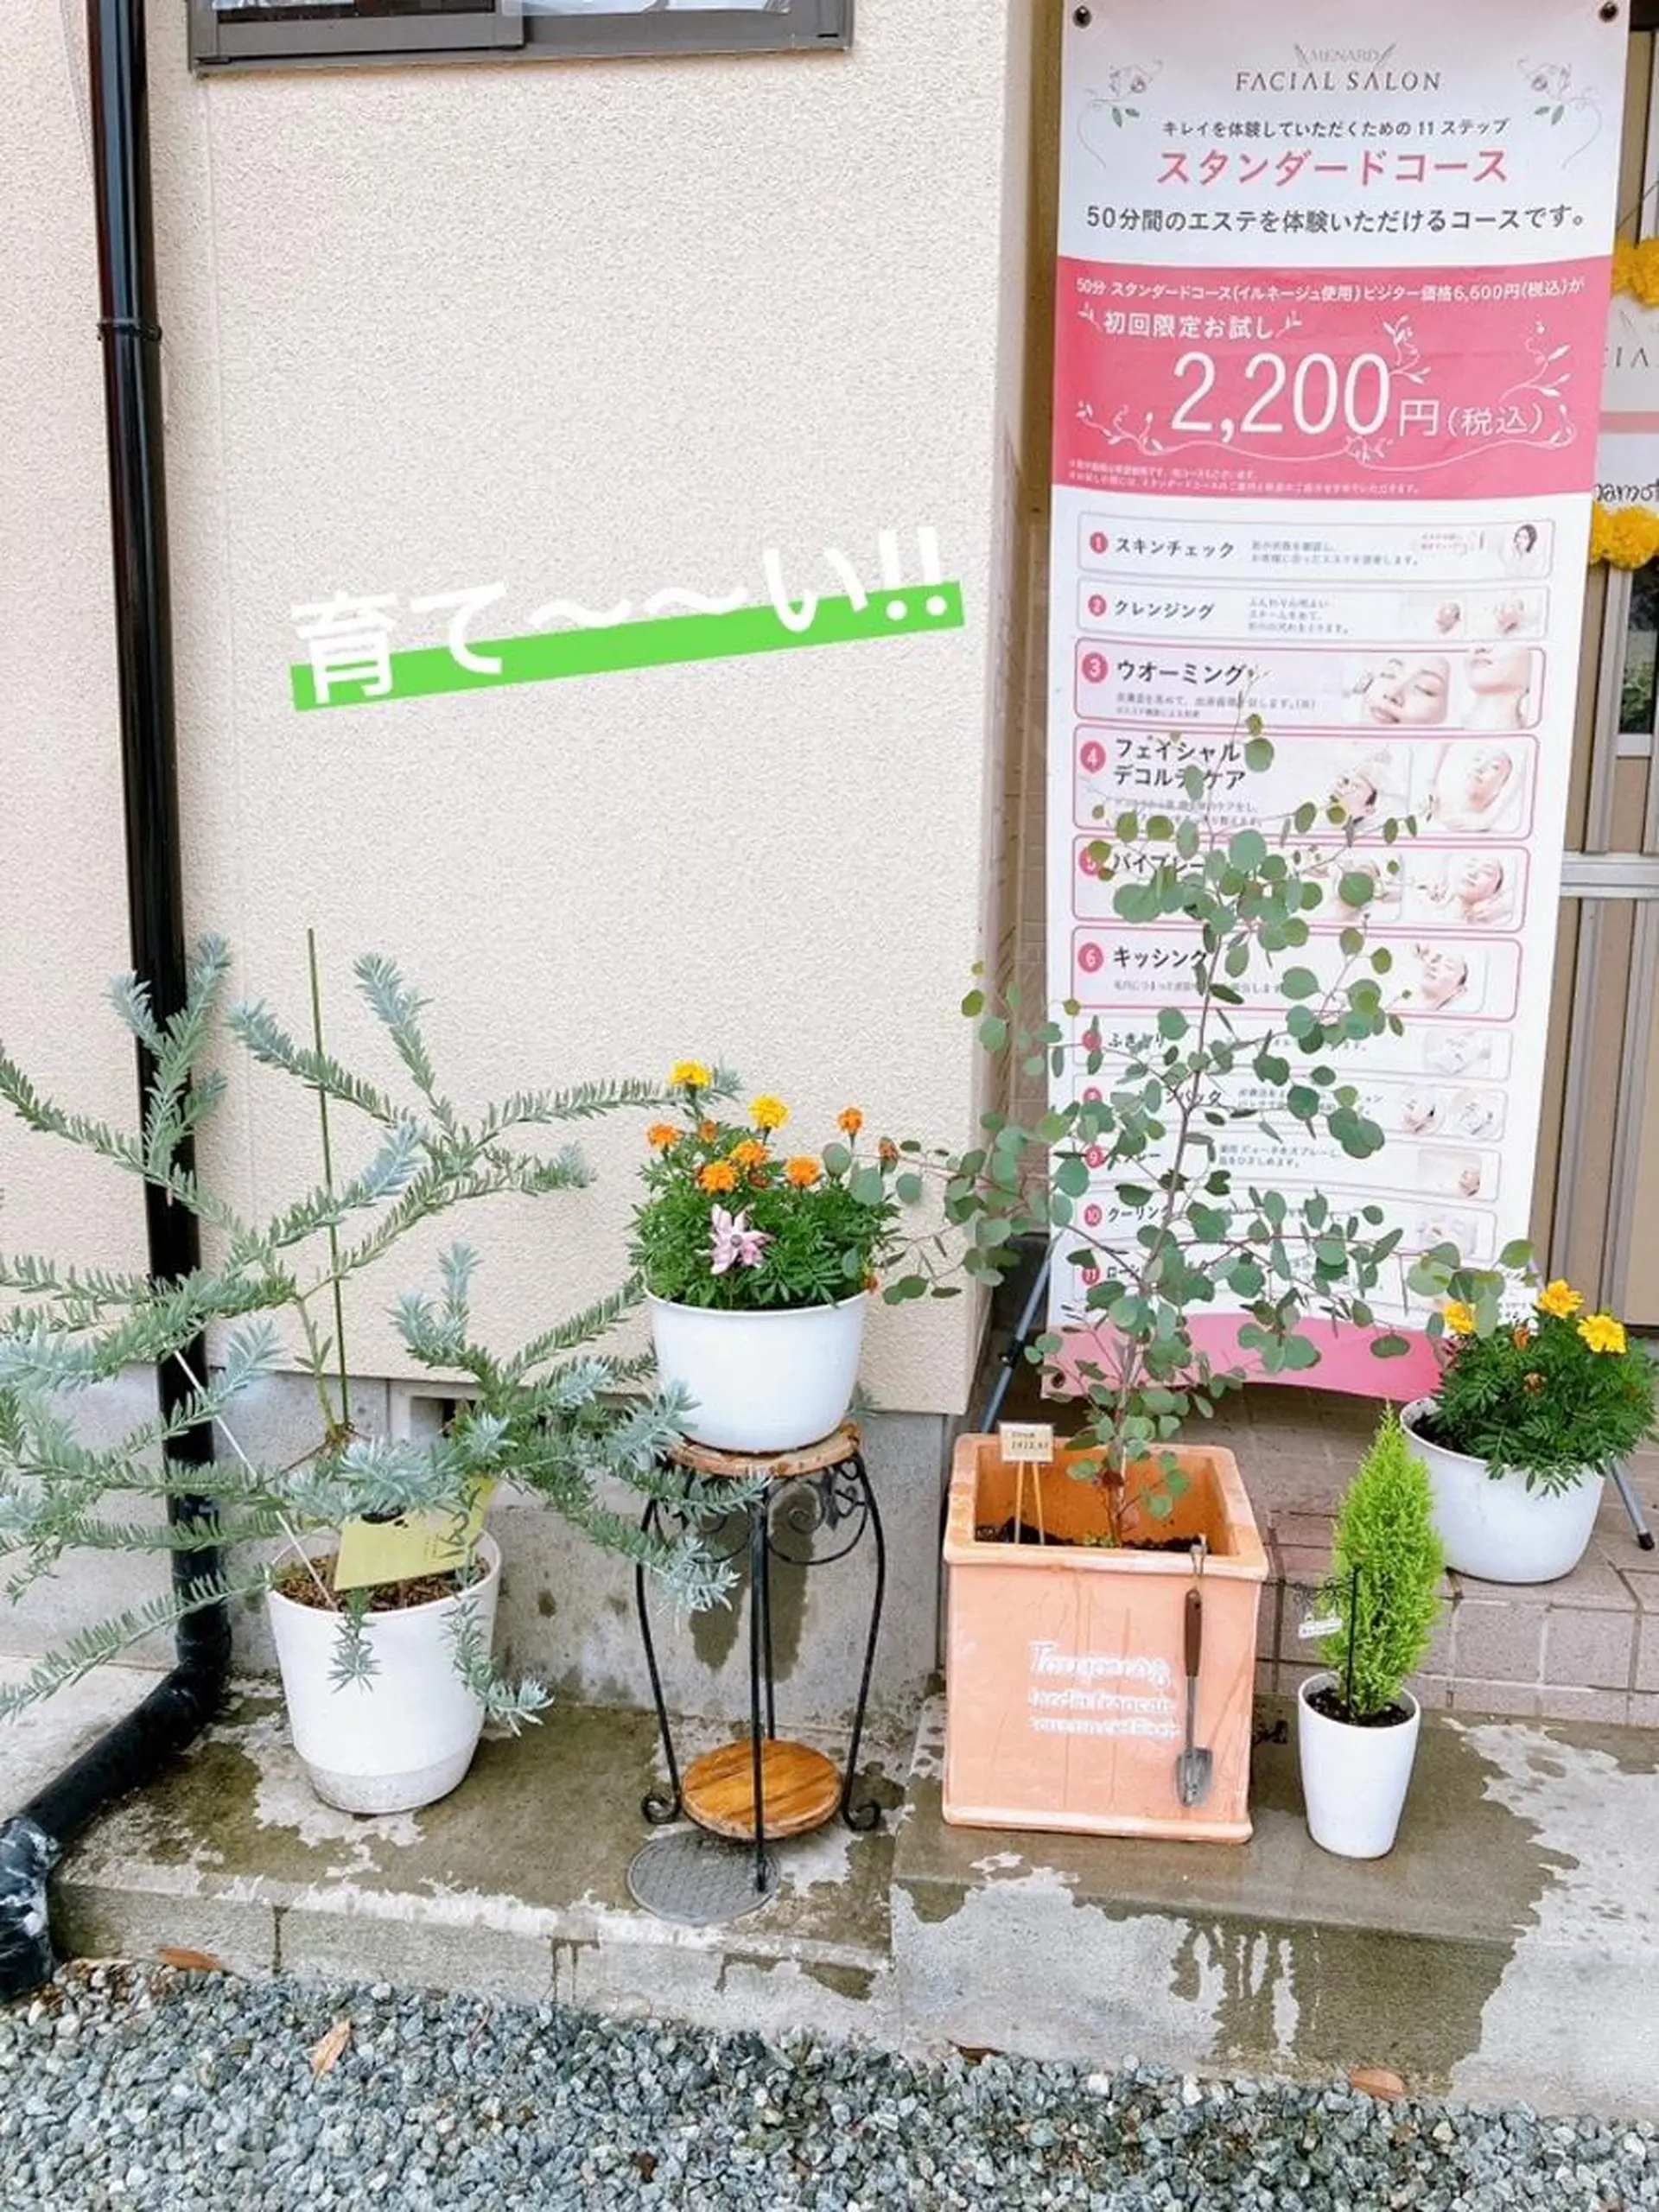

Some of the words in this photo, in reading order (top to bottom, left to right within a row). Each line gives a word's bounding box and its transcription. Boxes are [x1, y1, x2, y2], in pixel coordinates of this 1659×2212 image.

[1236, 72, 1335, 91] FACIAL
[1346, 71, 1441, 91] SALON
[1157, 149, 1507, 187] スタンダードコース
[1086, 204, 1584, 233] 50分間のエステを体験いただけるコースです。
[1103, 310, 1274, 340] 初回限定お試し
[1116, 537, 1234, 559] スキンチェック
[1115, 599, 1216, 620] クレンジング
[1115, 737, 1241, 763] フェイシャル
